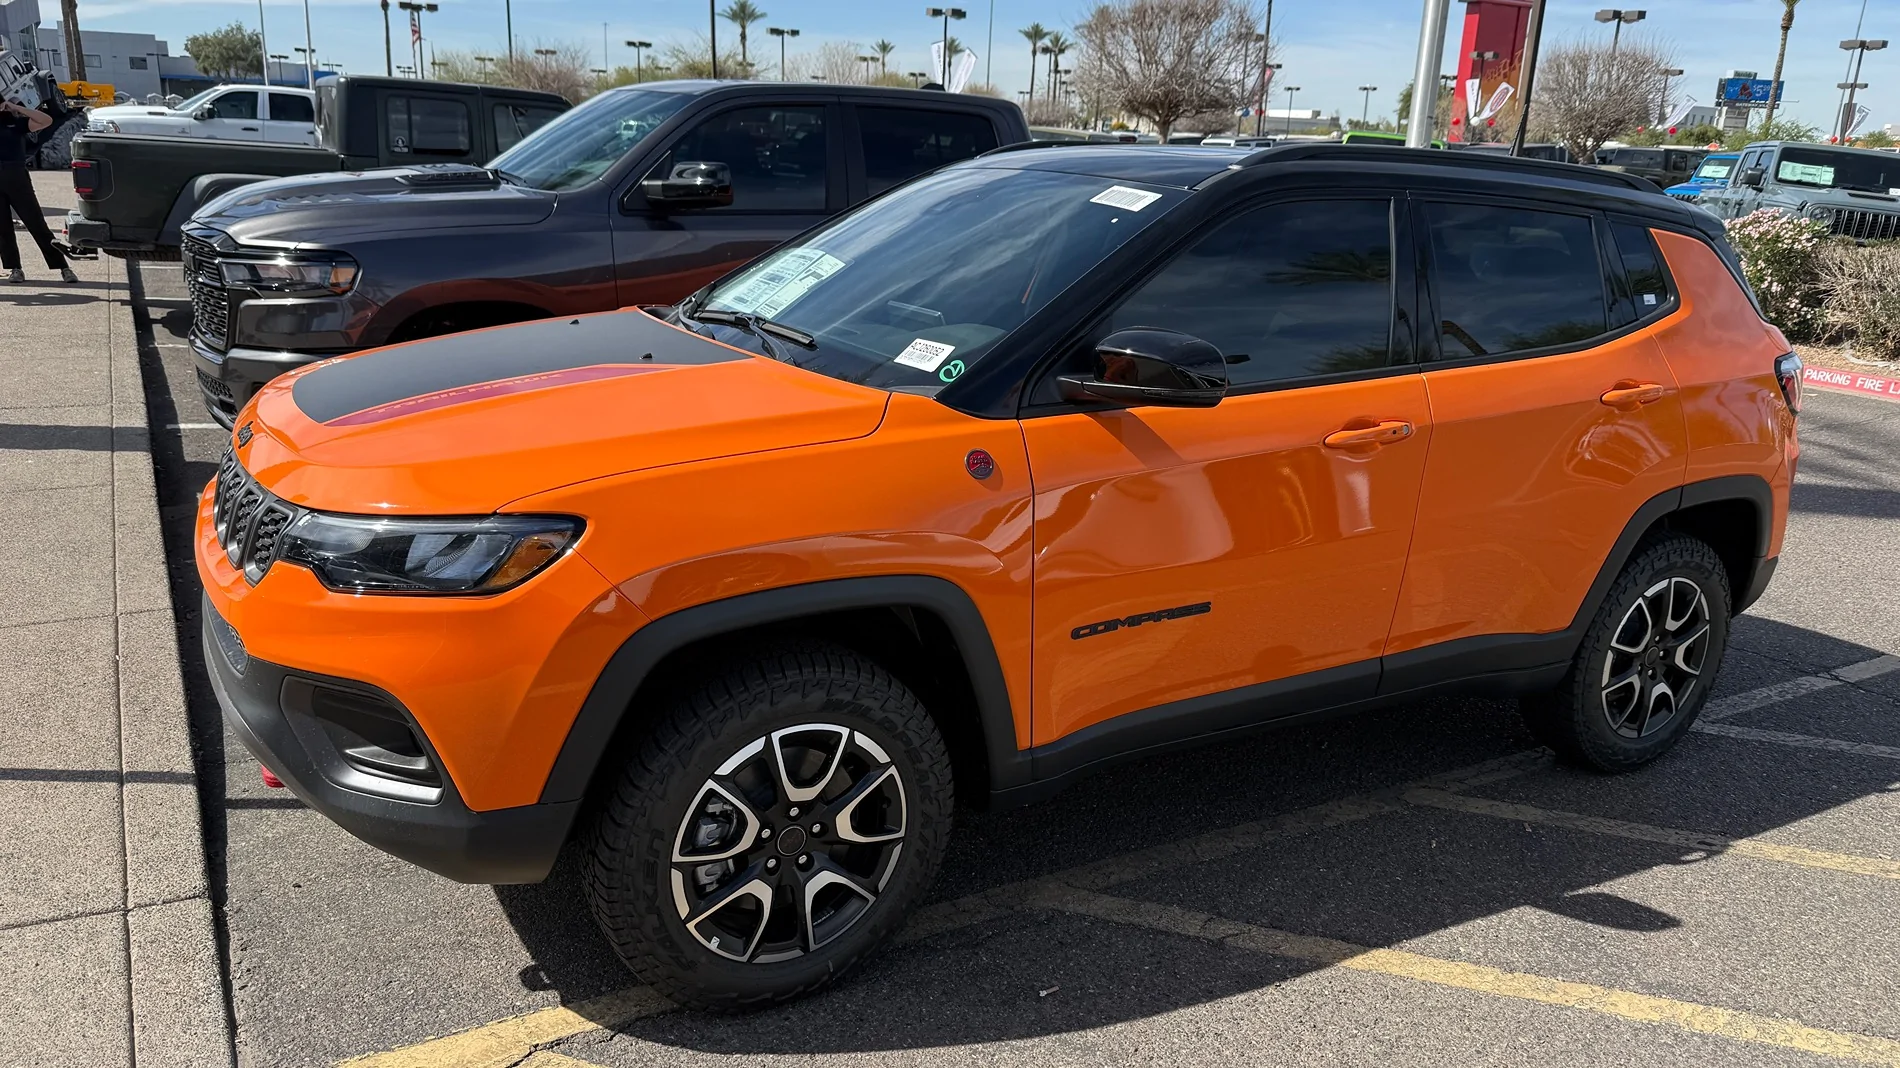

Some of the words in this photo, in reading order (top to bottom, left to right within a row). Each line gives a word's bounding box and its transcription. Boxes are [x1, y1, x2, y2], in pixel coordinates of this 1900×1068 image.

[1804, 368, 1851, 386] PARKING
[1856, 377, 1885, 392] FIRE
[1070, 601, 1212, 640] COMPASS
[642, 829, 698, 974] FALKEN
